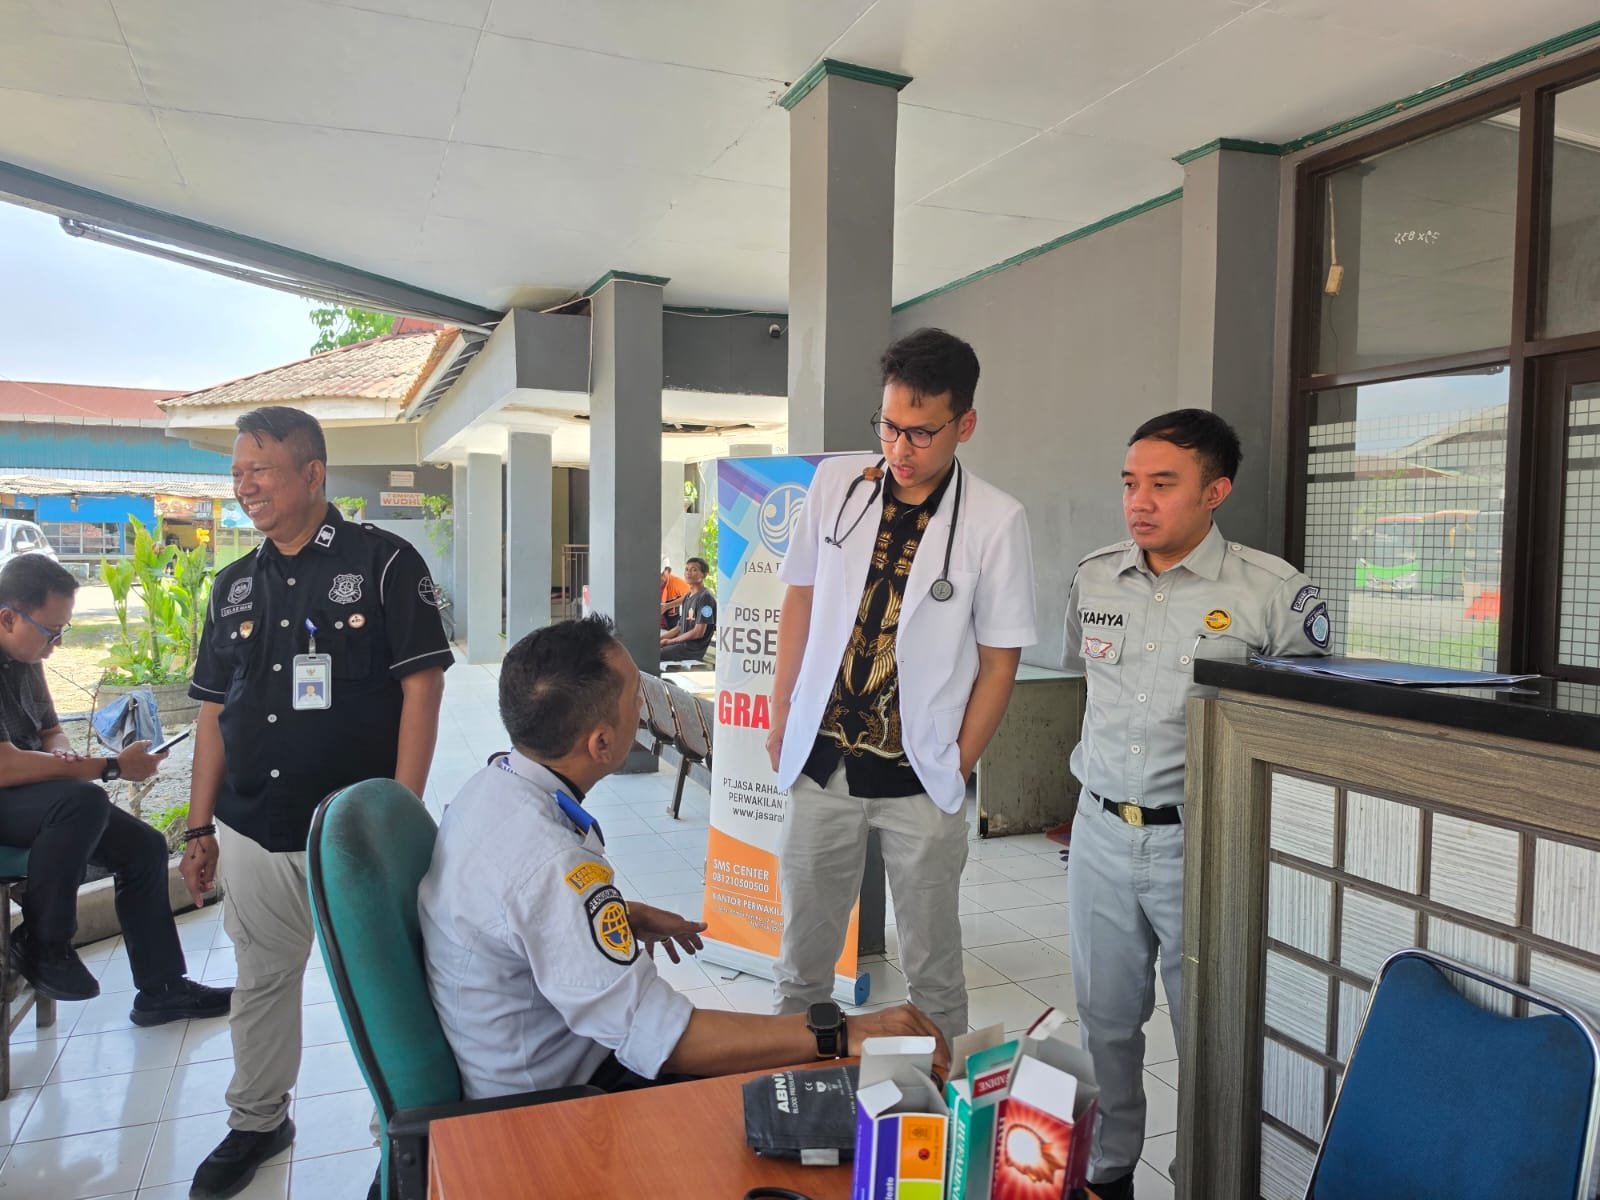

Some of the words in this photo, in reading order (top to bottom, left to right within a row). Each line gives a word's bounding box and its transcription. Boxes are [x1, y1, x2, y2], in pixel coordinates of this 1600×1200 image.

[744, 560, 772, 575] JASA
[735, 607, 760, 622] POS
[719, 626, 777, 655] KESE
[728, 791, 783, 808] PERWAKILAN
[713, 859, 730, 872] SMS
[733, 864, 769, 880] CENTER
[712, 893, 741, 906] KANTOR
